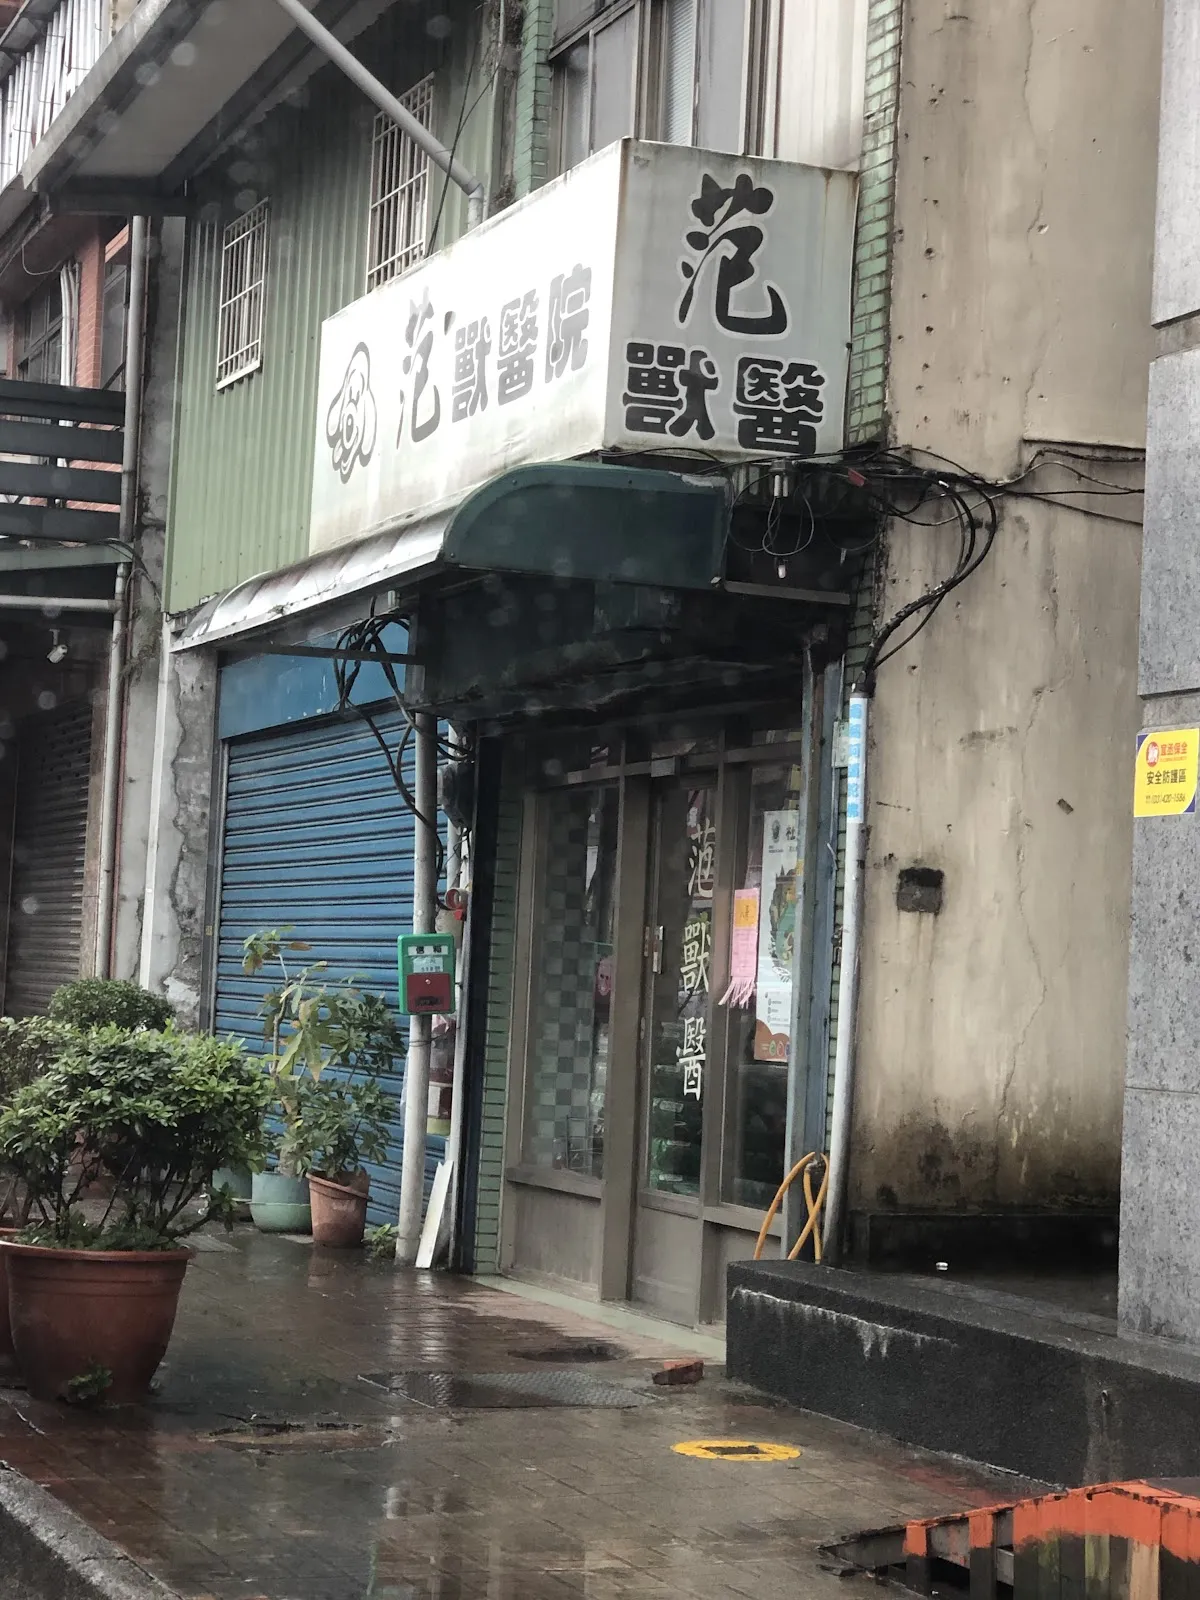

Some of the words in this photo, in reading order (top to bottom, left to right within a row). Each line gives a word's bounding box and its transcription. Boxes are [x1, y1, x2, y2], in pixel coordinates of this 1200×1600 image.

[678, 173, 788, 335] 范
[622, 342, 826, 455] 獸醫
[1146, 768, 1187, 786] 安全防護區
